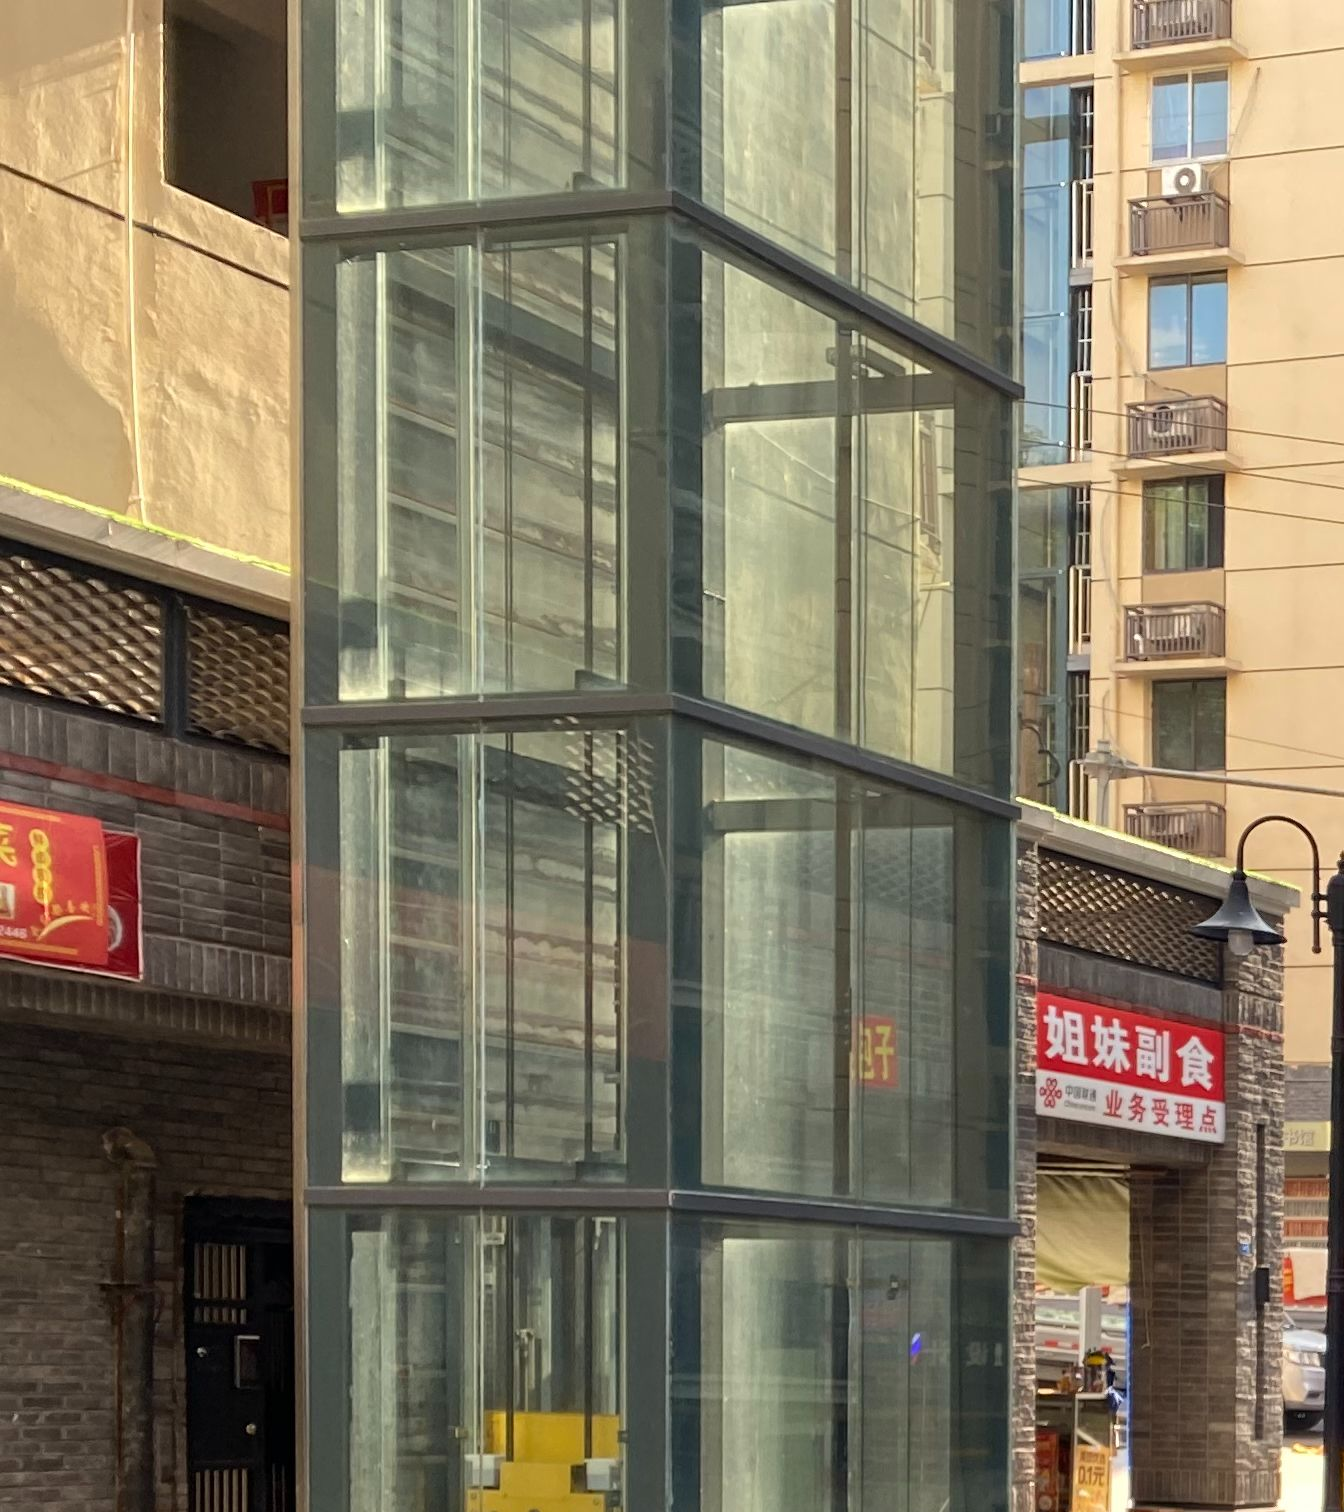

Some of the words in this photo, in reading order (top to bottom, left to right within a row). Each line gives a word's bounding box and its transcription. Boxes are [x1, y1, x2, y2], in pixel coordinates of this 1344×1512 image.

[1043, 1005, 1216, 1092] 姐妹副食
[1103, 1089, 1218, 1134] 业务受理点
